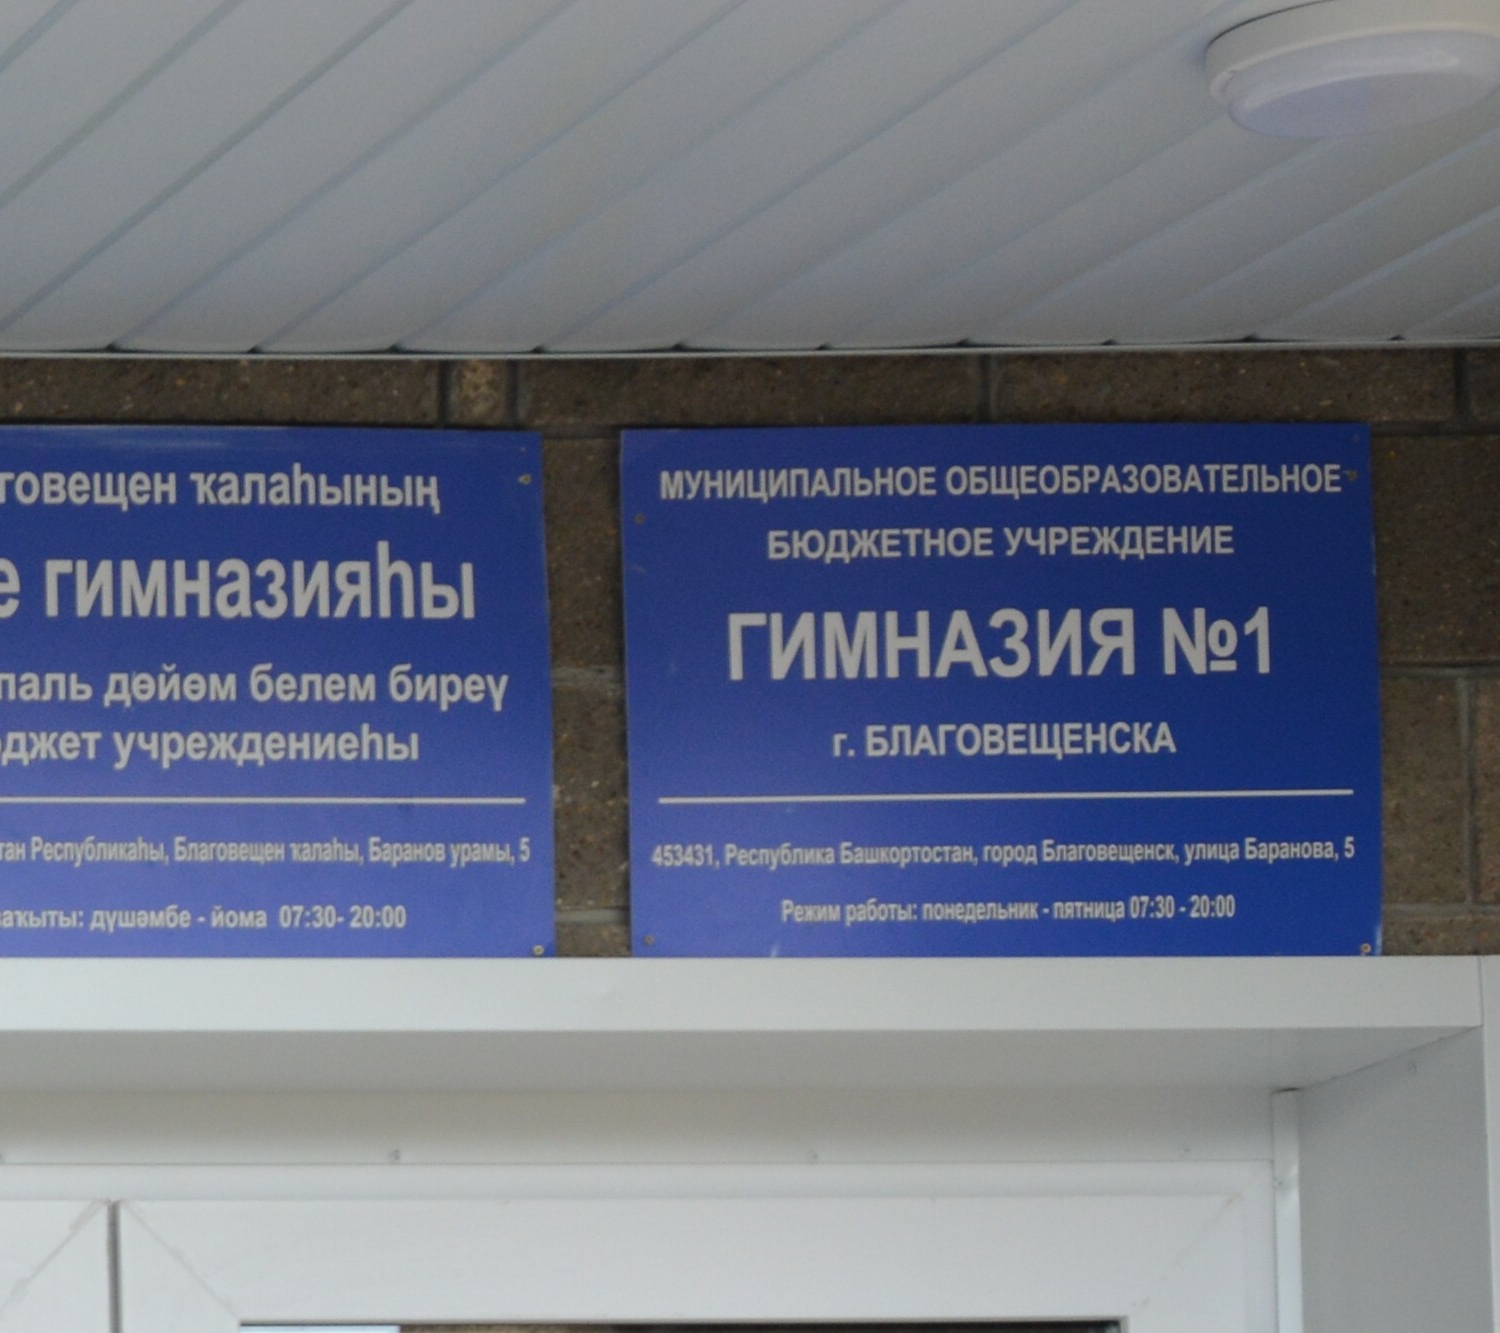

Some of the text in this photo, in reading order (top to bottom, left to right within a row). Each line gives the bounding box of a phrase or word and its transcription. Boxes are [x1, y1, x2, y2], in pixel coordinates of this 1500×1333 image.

[660, 463, 1342, 503] МУНИЦИПАЛЬНОЕ ОБЩЕОБРАЗОВАТЕЛЬНОЕ
[768, 525, 1235, 564] БЮДЖЕТНОЕ УЧРЕЖДЕНИЕ
[727, 606, 1272, 681] ГИМНАЗИЯ №1
[250, 664, 376, 702] белем
[833, 720, 1177, 760] г. БЛАГОВЕЩЕНСКА
[174, 836, 285, 866] Благовещен
[368, 836, 446, 867] Баранов
[450, 842, 515, 868] урамы,
[519, 837, 530, 862] 5
[652, 836, 1355, 870] 453431, Республика Башкортостан, город Благовещенск, улица Баранова, 5
[211, 905, 268, 928] йома
[350, 905, 407, 928] 20:00
[781, 900, 840, 923] Режим
[845, 898, 917, 927] работы:
[922, 901, 1039, 924] понедельник
[1053, 900, 1125, 922] пятница
[1129, 896, 1175, 919] 07:30
[1190, 895, 1236, 918] 20:00
